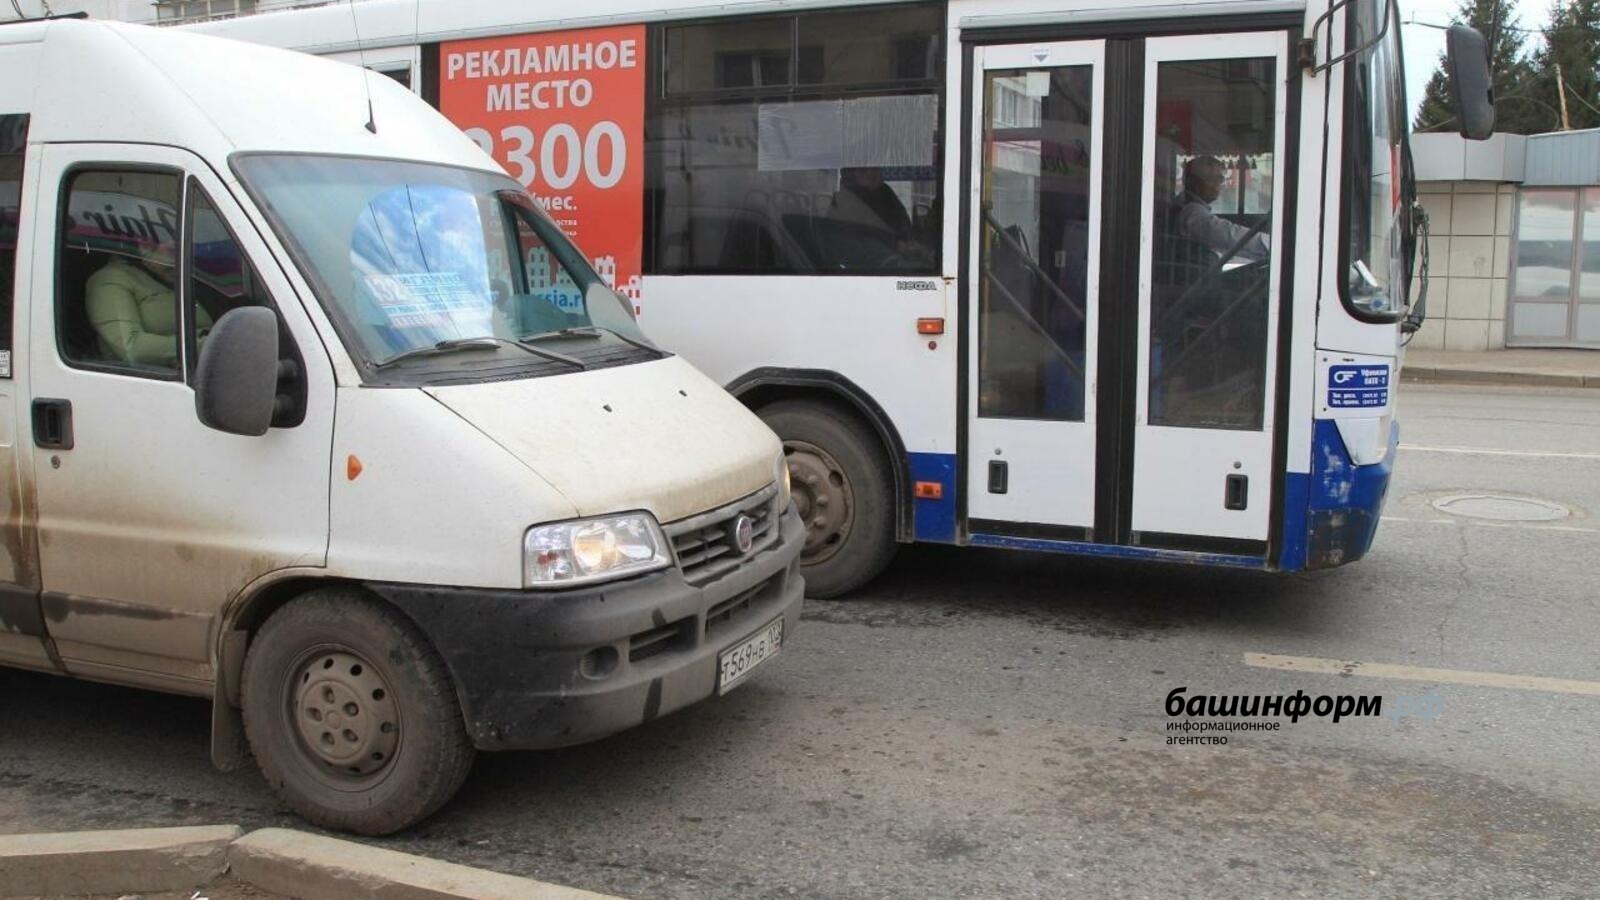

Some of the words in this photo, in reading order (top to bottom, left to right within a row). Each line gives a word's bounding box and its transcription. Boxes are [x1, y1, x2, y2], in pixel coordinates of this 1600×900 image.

[447, 40, 636, 80] РЕКЛАМНОЕ
[486, 78, 593, 112] МЕСТО
[532, 192, 577, 211] мес.
